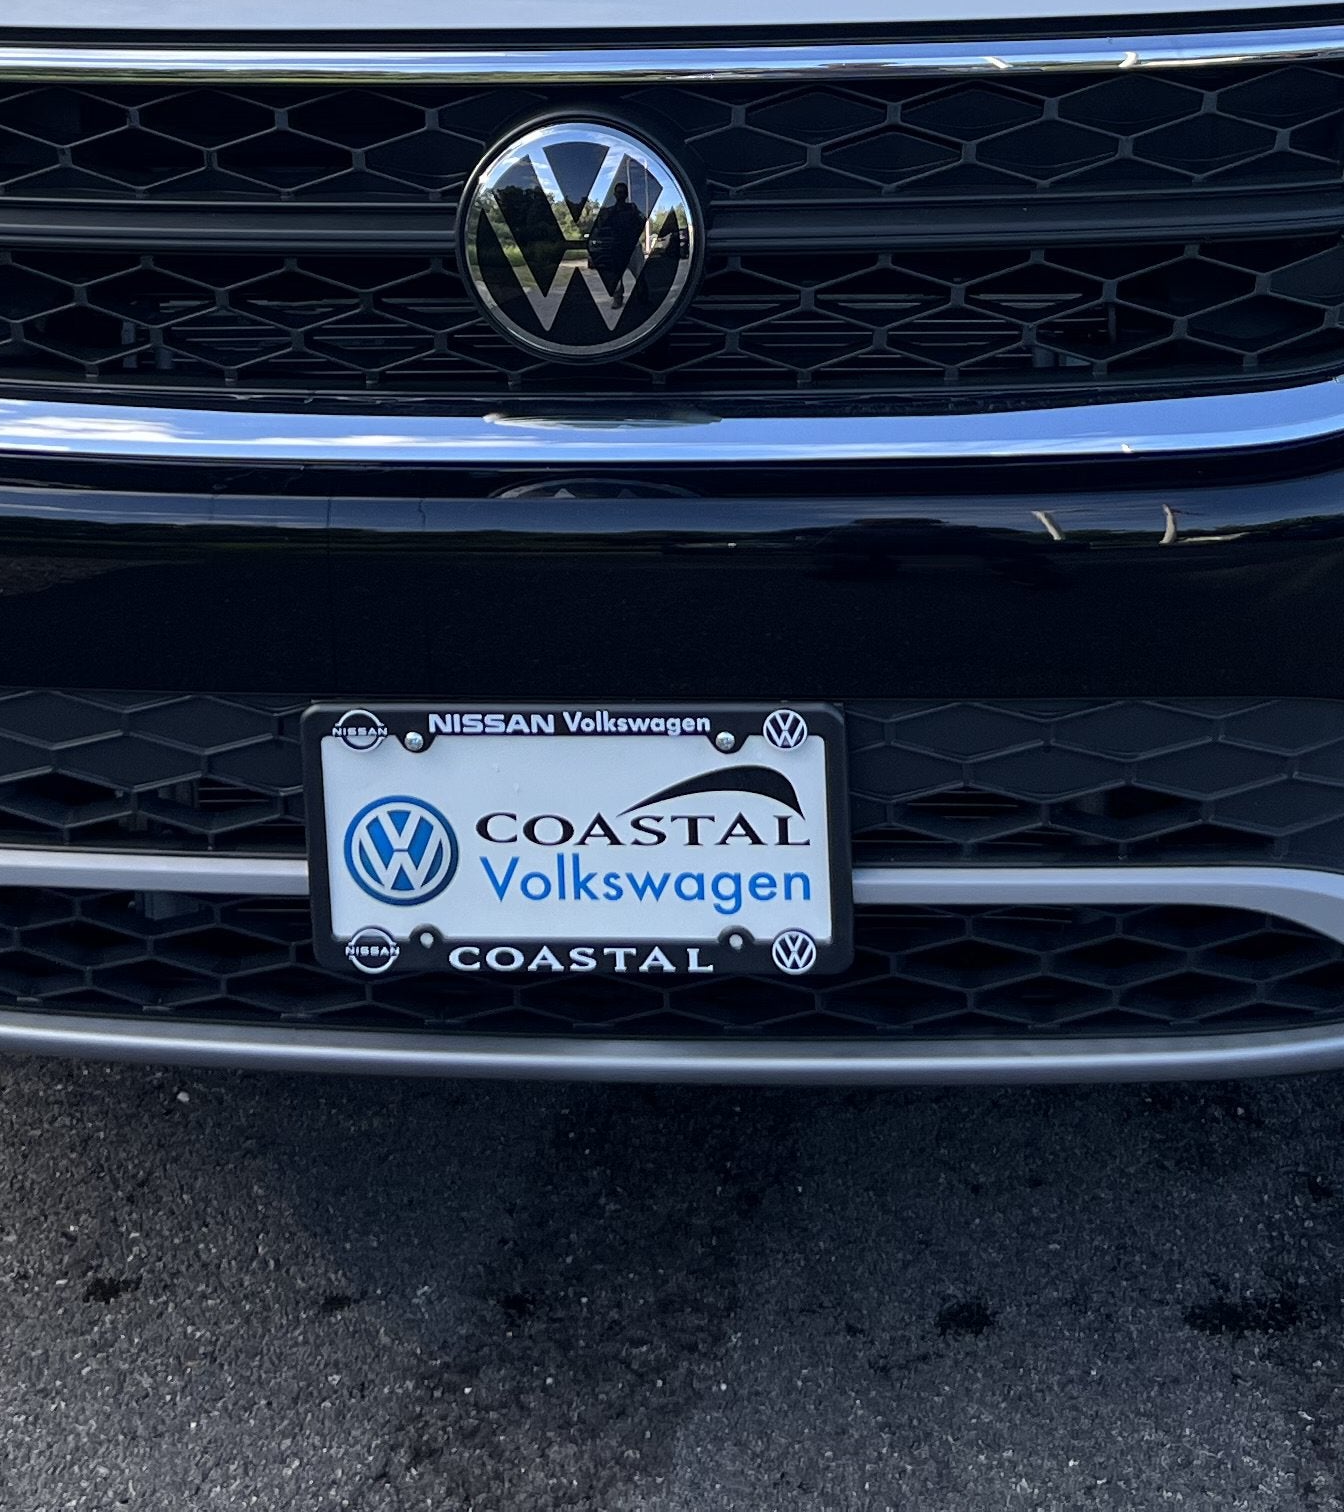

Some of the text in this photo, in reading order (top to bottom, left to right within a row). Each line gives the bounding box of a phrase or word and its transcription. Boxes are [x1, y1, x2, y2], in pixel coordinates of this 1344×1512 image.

[332, 726, 388, 737] NISSAN
[428, 710, 711, 736] NISSAN Volkswagen
[475, 812, 811, 846] COASTAL
[479, 853, 811, 915] Volkswagen
[345, 946, 400, 957] NISSAN
[448, 945, 714, 973] COASTAL
